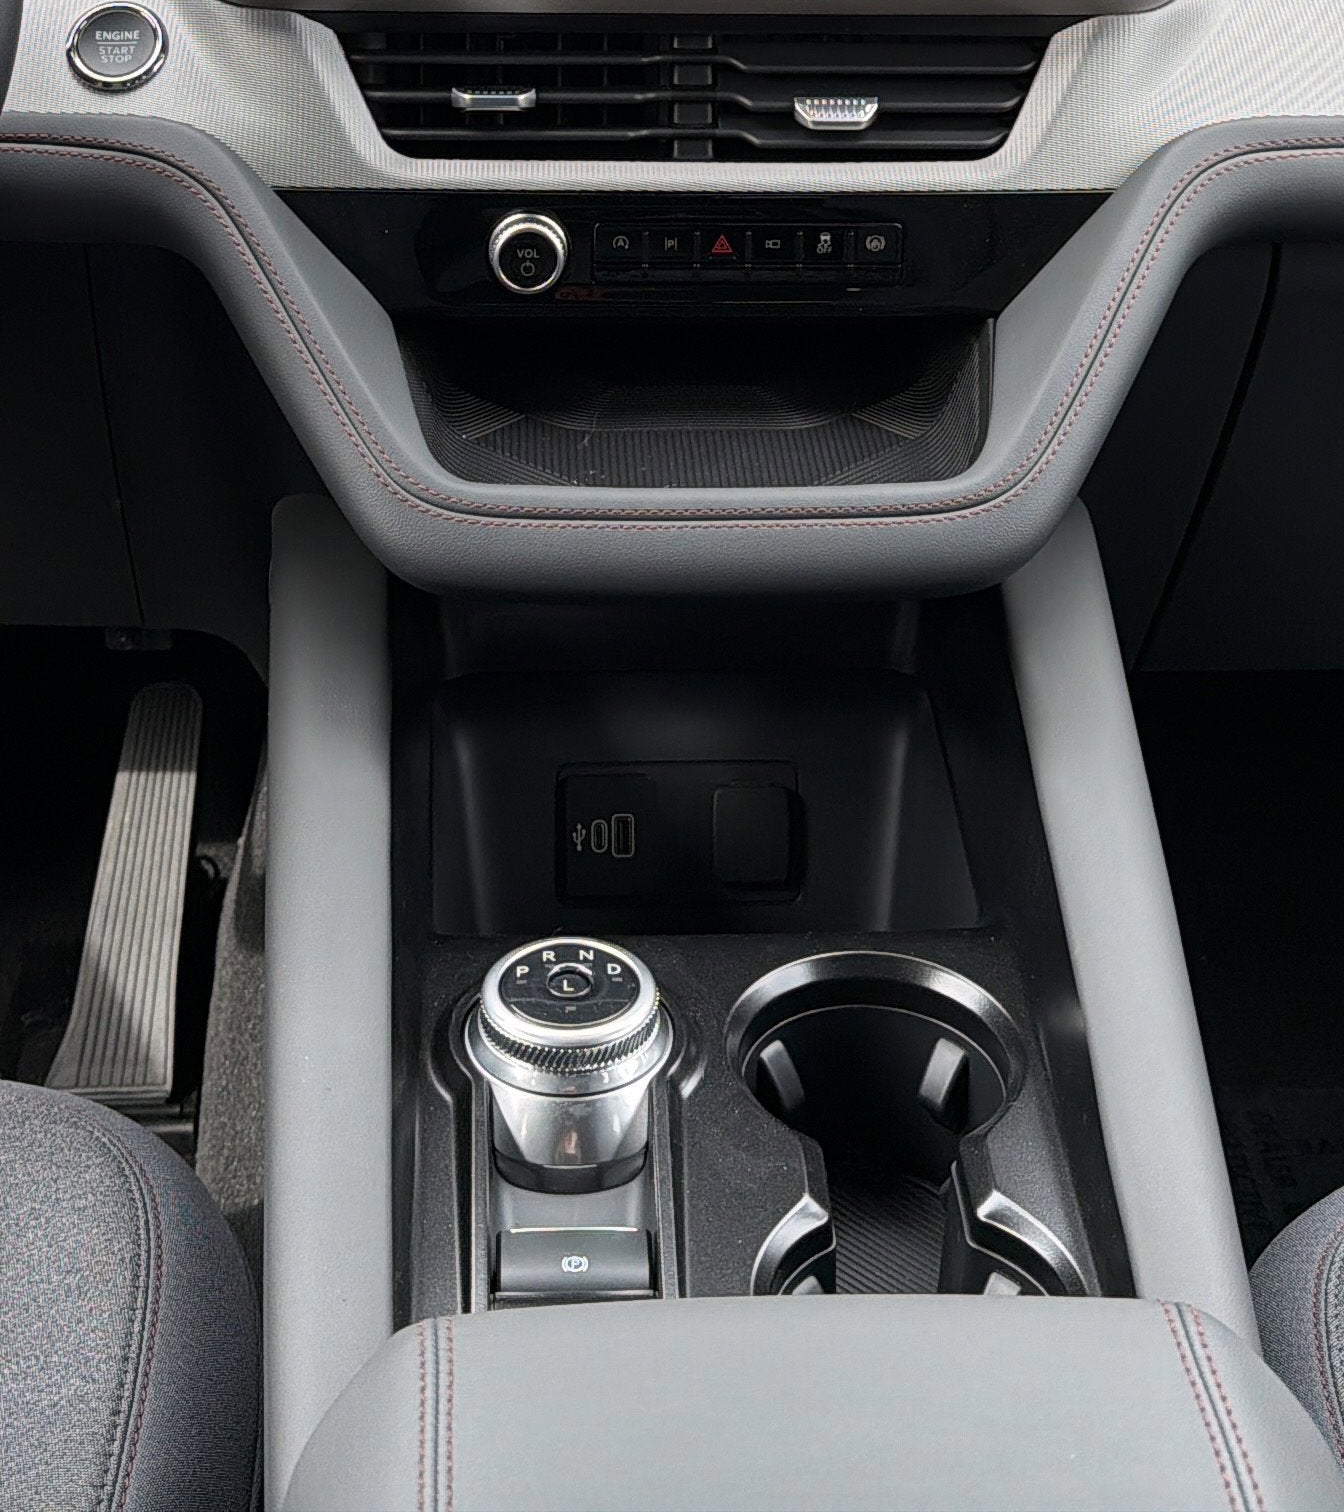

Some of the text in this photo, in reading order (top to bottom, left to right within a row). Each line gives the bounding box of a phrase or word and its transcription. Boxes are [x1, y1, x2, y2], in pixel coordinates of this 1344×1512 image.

[95, 30, 140, 41] ENGINE
[98, 45, 135, 55] START
[100, 54, 132, 64] STOP
[517, 248, 541, 259] VOL
[816, 246, 832, 254] OFF
[516, 950, 621, 978] P R N D
[563, 979, 574, 991] L
